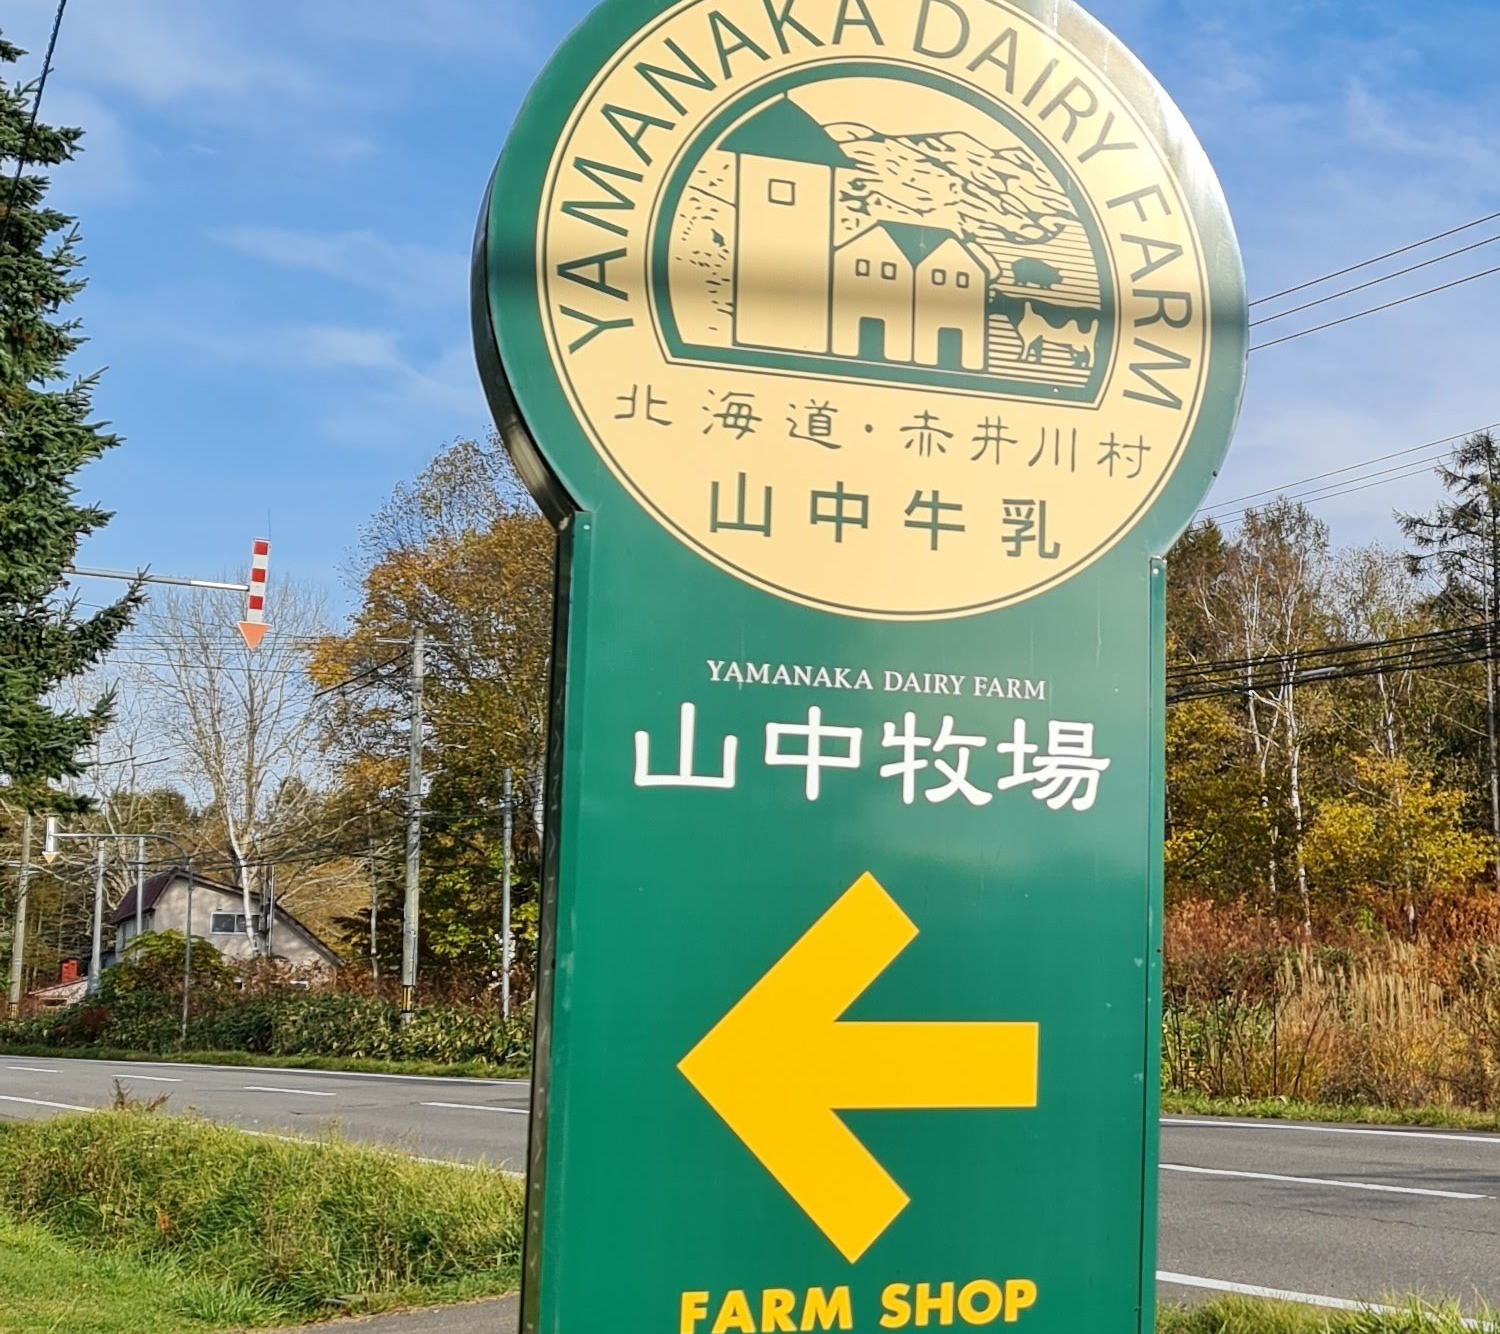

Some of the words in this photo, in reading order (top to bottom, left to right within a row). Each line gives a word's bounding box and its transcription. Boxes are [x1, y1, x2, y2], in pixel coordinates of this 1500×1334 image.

[1106, 183, 1193, 412] FARM
[710, 471, 1060, 560] 山中牛乳
[706, 658, 874, 691] YAMANAKA
[883, 669, 966, 696] DAIRY
[972, 675, 1047, 701] FARM
[632, 701, 1112, 812] 山中牧場
[878, 1278, 1038, 1329] SHOP
